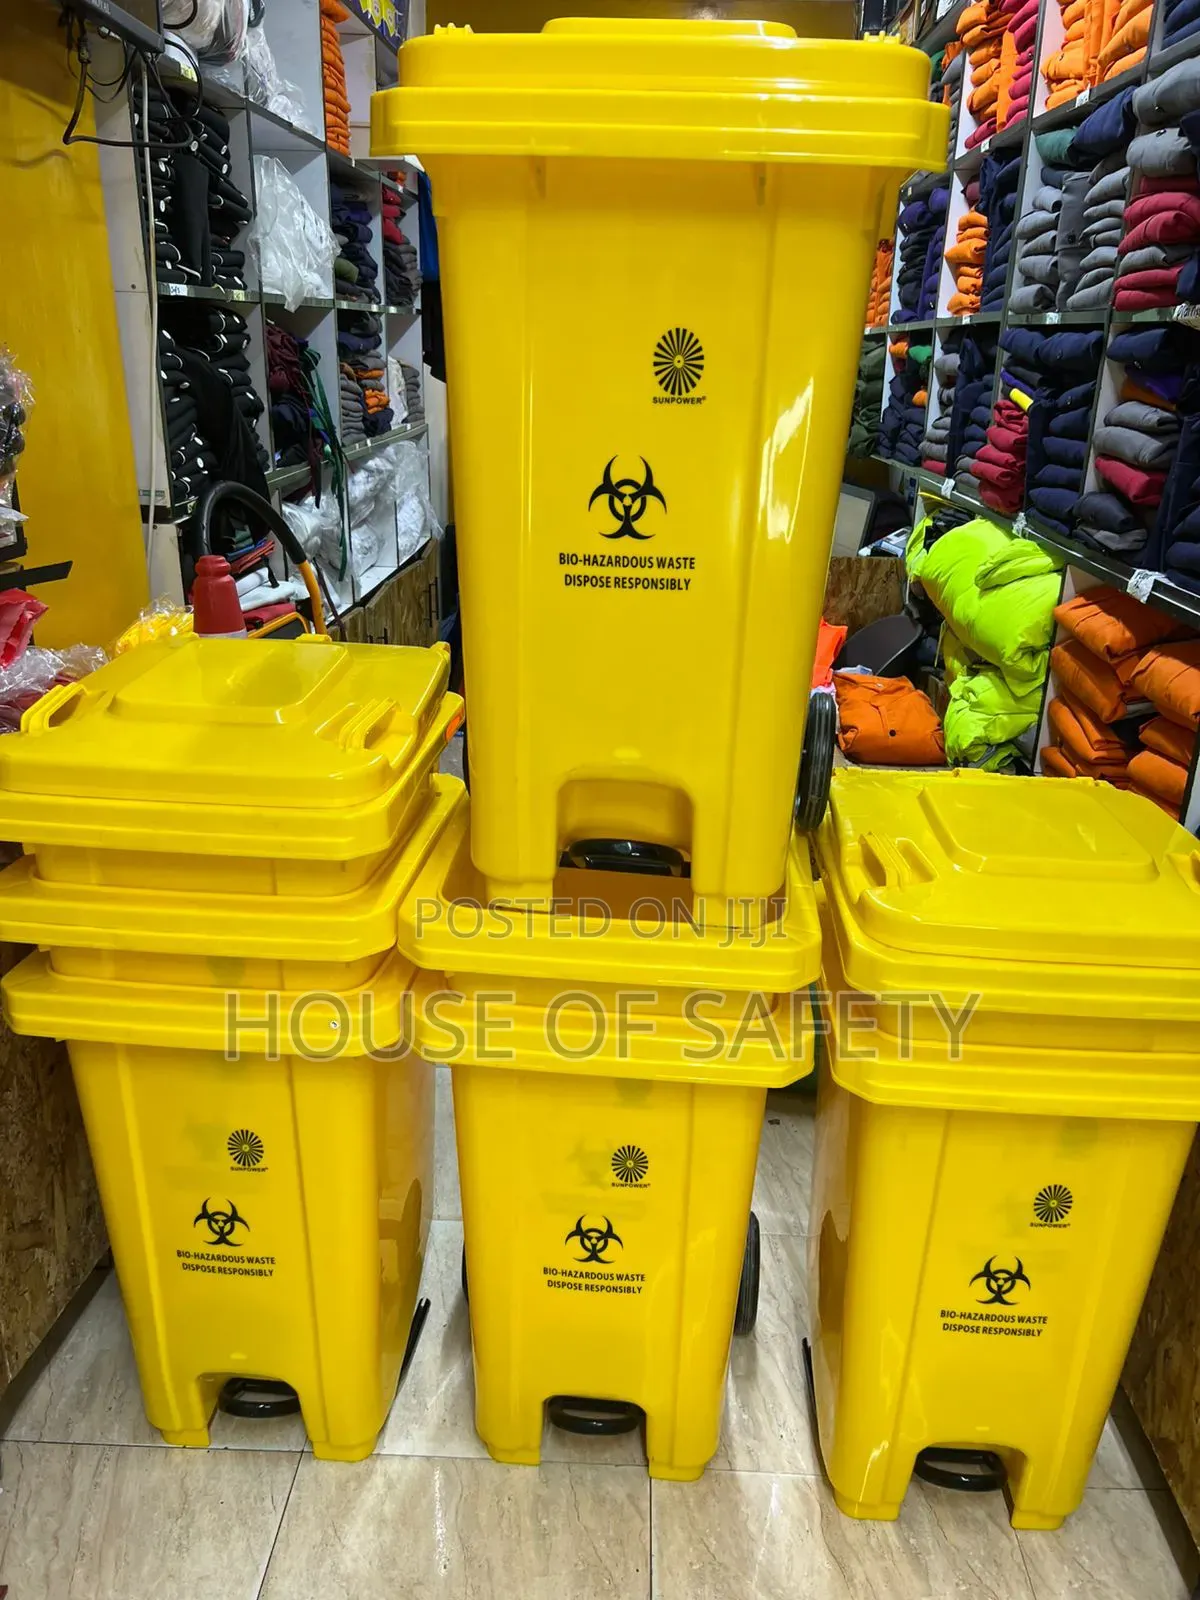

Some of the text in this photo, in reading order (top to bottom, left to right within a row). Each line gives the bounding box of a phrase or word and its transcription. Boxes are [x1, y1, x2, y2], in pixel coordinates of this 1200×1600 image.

[559, 552, 696, 570] BIO-HAZARDOUS WASTE
[564, 573, 691, 591] DISPOSE RESPONSIBLY
[176, 1250, 276, 1265] BIO-HAZARDOUS WASTE
[182, 1262, 274, 1277] DISPOSE RESPONSIBLY
[543, 1267, 645, 1282] BIO-HAZARDOUS WASTE
[547, 1280, 643, 1294] DISPOSE RESPONSIBLY
[940, 1309, 1048, 1325] BIO-HAZARDOUS WASTE
[942, 1323, 1043, 1337] DISPOSE RESPONSIBLY
